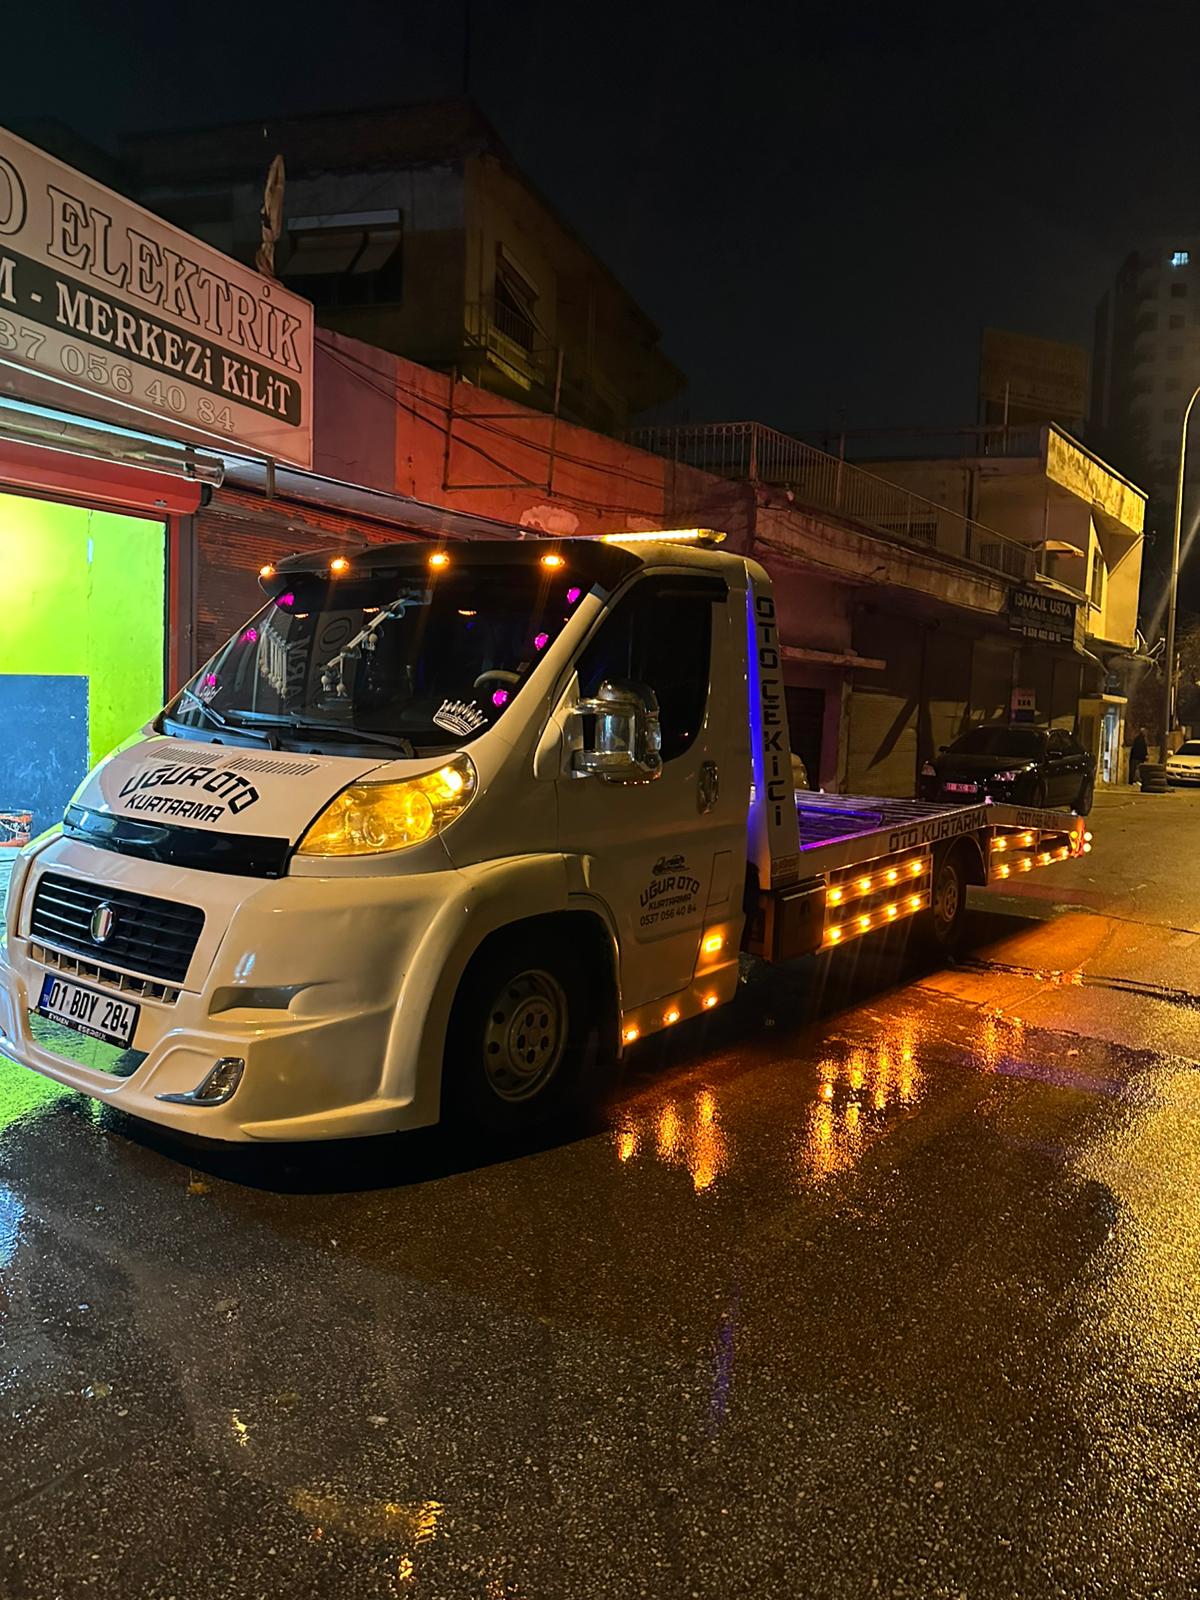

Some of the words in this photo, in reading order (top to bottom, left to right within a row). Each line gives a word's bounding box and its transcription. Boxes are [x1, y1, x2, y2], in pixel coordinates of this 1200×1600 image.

[60, 344, 134, 395] 056
[145, 379, 188, 414] 40
[197, 397, 236, 433] 84
[1050, 600, 1072, 617] USTA
[118, 763, 217, 798] UĞUR
[202, 770, 260, 815] OTO
[124, 794, 226, 823] KURTARMA
[888, 828, 918, 852] OTO
[921, 809, 989, 843] KURTARMA
[640, 877, 676, 908] UĞUR
[677, 876, 700, 895] OTO
[48, 982, 69, 1011] 01
[101, 1001, 129, 1036] 284
